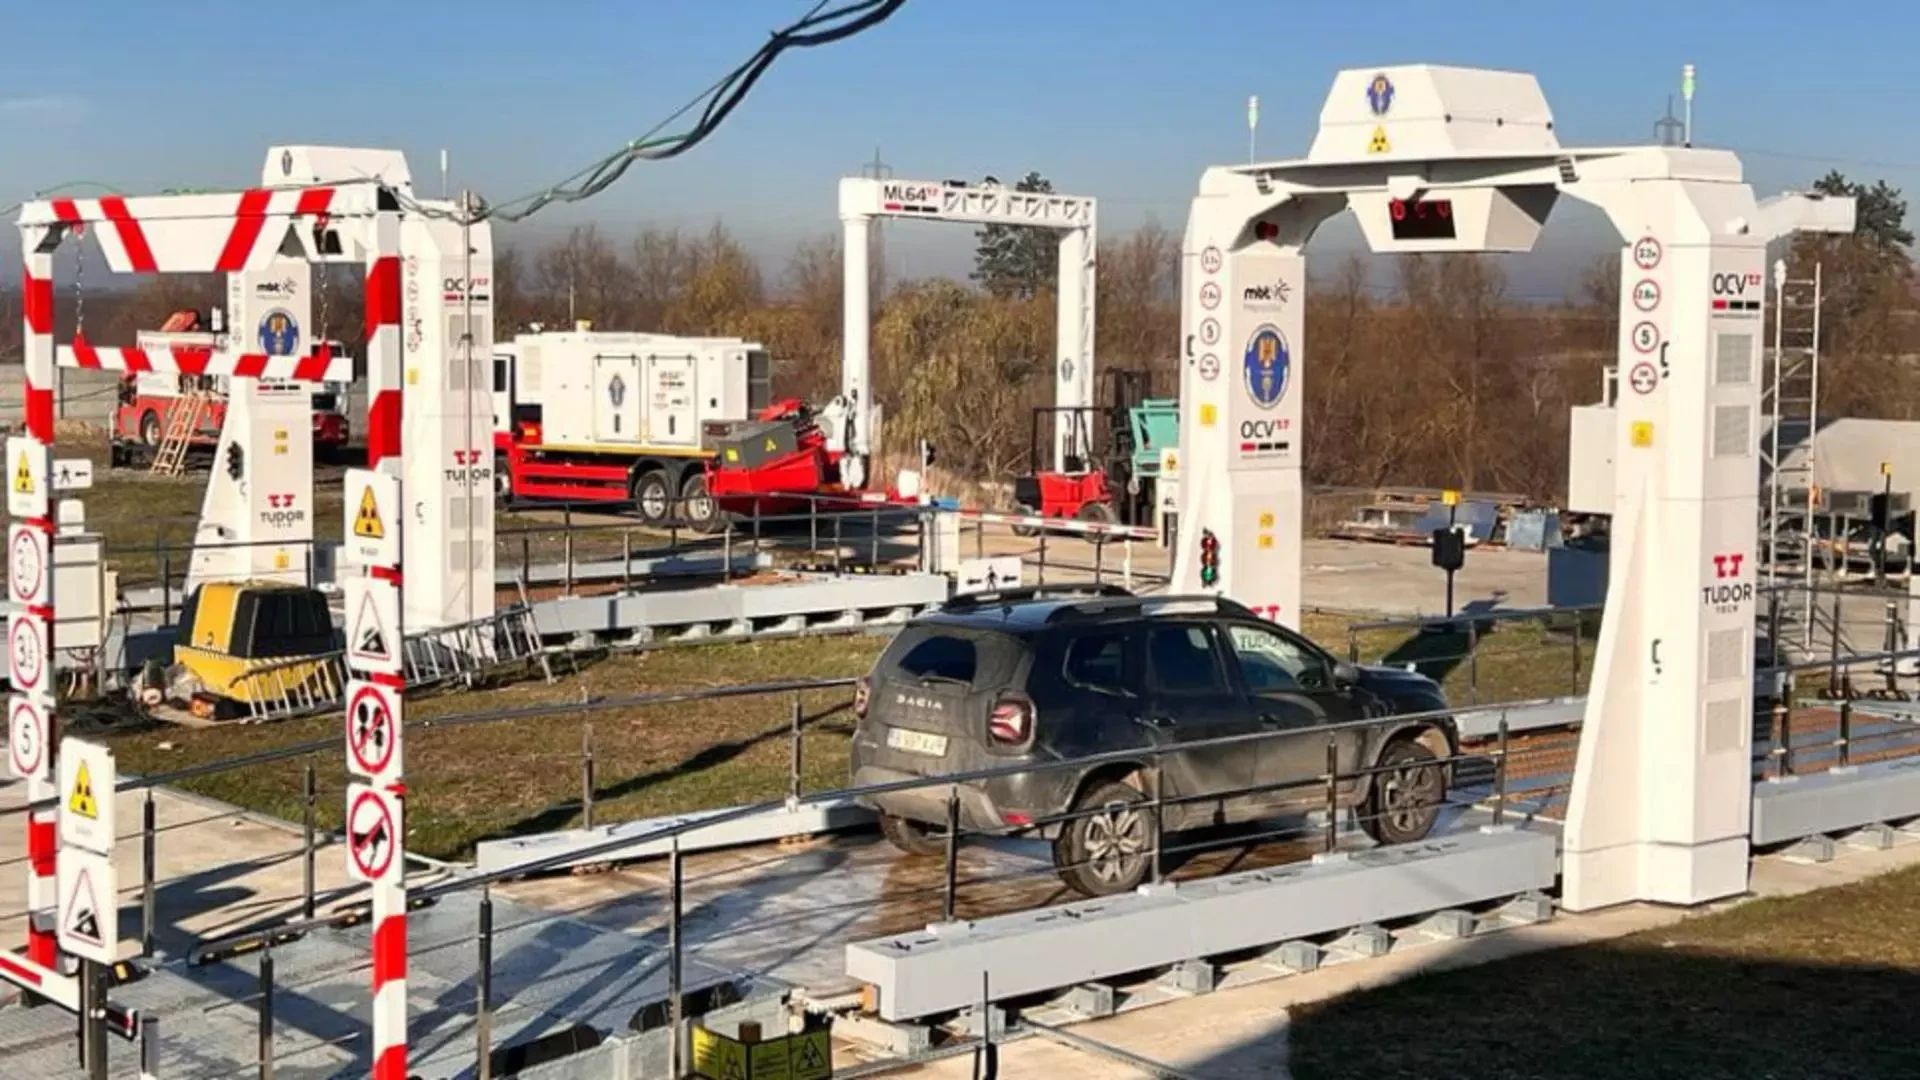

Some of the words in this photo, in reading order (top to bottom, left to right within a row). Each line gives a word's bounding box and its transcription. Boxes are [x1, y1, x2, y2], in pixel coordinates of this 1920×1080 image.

[884, 185, 926, 202] ML64
[1244, 285, 1272, 300] mbt
[1712, 272, 1746, 295] OCV
[1641, 328, 1650, 346] 5
[1240, 419, 1275, 439] OCV
[260, 510, 304, 524] TUDOR
[1703, 582, 1752, 605] TUDOR
[896, 692, 943, 710] DACIA
[21, 723, 31, 755] 5
